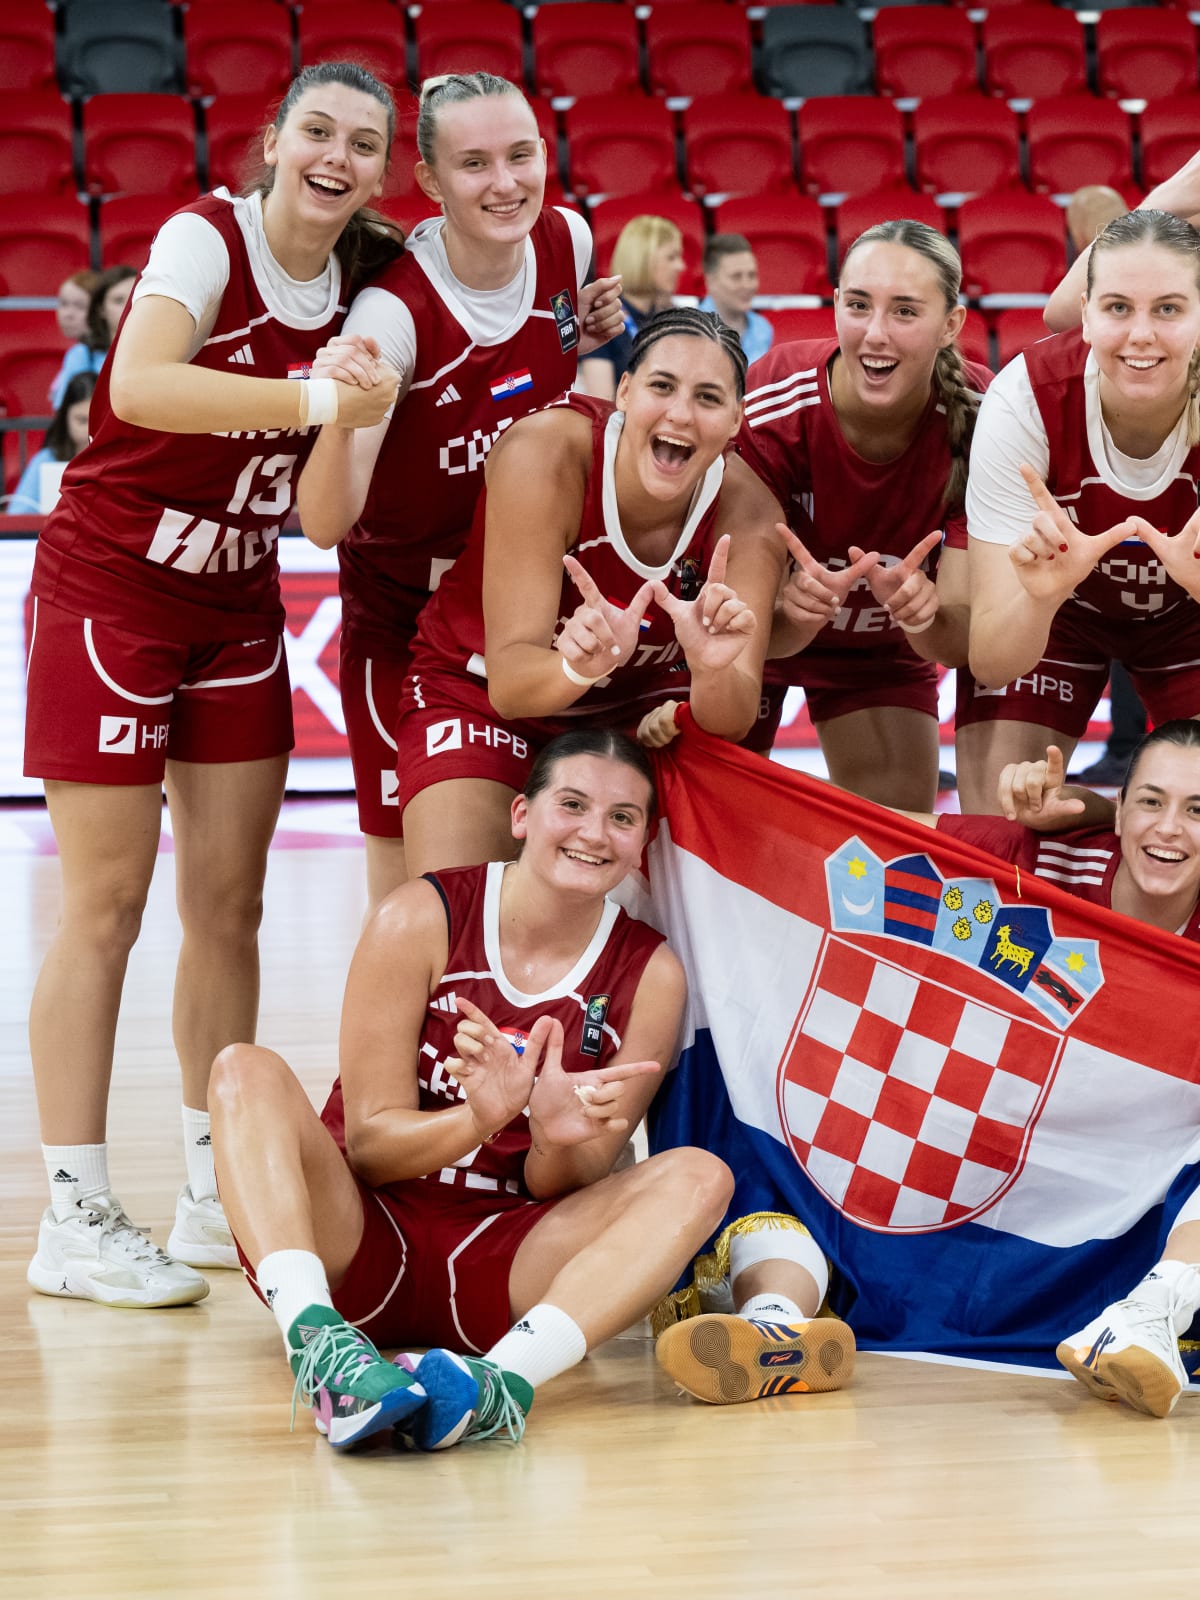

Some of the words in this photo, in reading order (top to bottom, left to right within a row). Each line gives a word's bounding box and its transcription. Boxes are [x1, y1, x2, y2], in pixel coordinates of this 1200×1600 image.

[226, 454, 298, 516] 13
[1014, 673, 1074, 702] HPB
[468, 723, 528, 759] HPB
